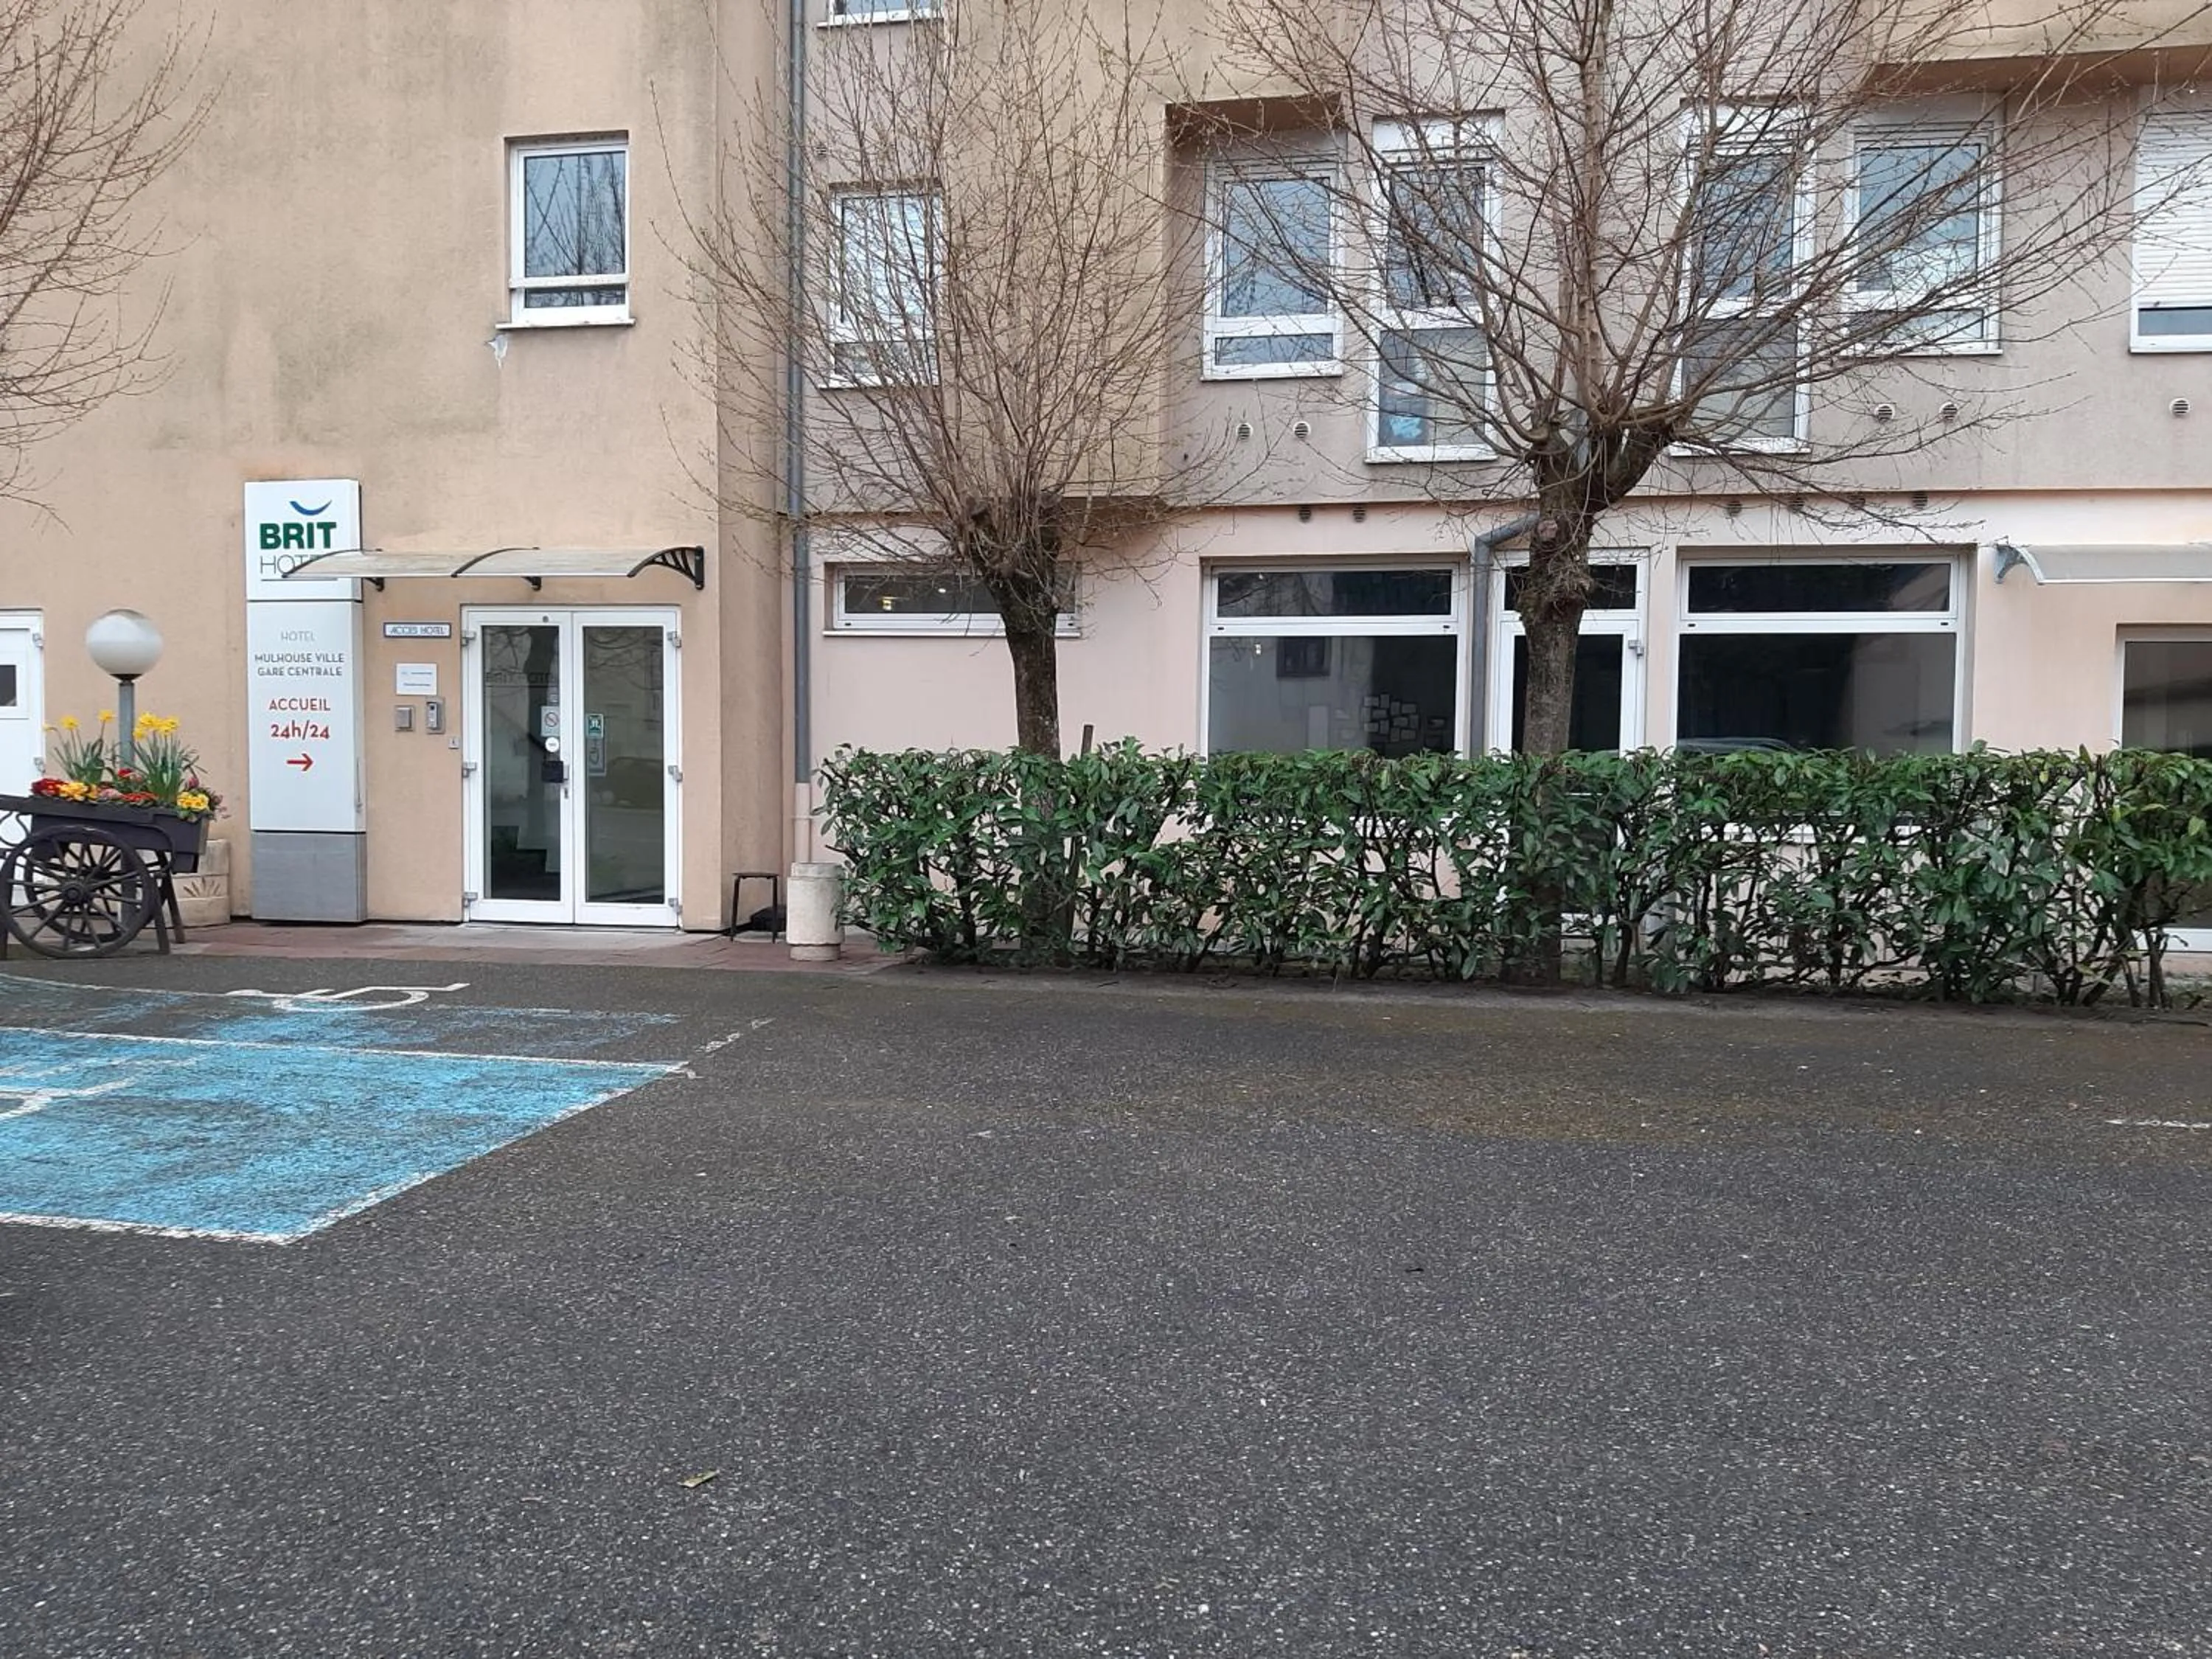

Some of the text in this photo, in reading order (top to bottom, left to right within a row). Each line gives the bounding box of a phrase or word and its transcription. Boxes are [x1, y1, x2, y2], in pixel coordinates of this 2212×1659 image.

[260, 521, 337, 550] BRIT
[260, 554, 324, 574] HOT
[280, 630, 316, 641] HOTEL
[254, 653, 344, 663] MULHOUSE VILLE
[257, 667, 343, 676] GARE CENTRALE
[269, 698, 331, 712] ACCUEIL
[271, 719, 331, 740] 24h/24
